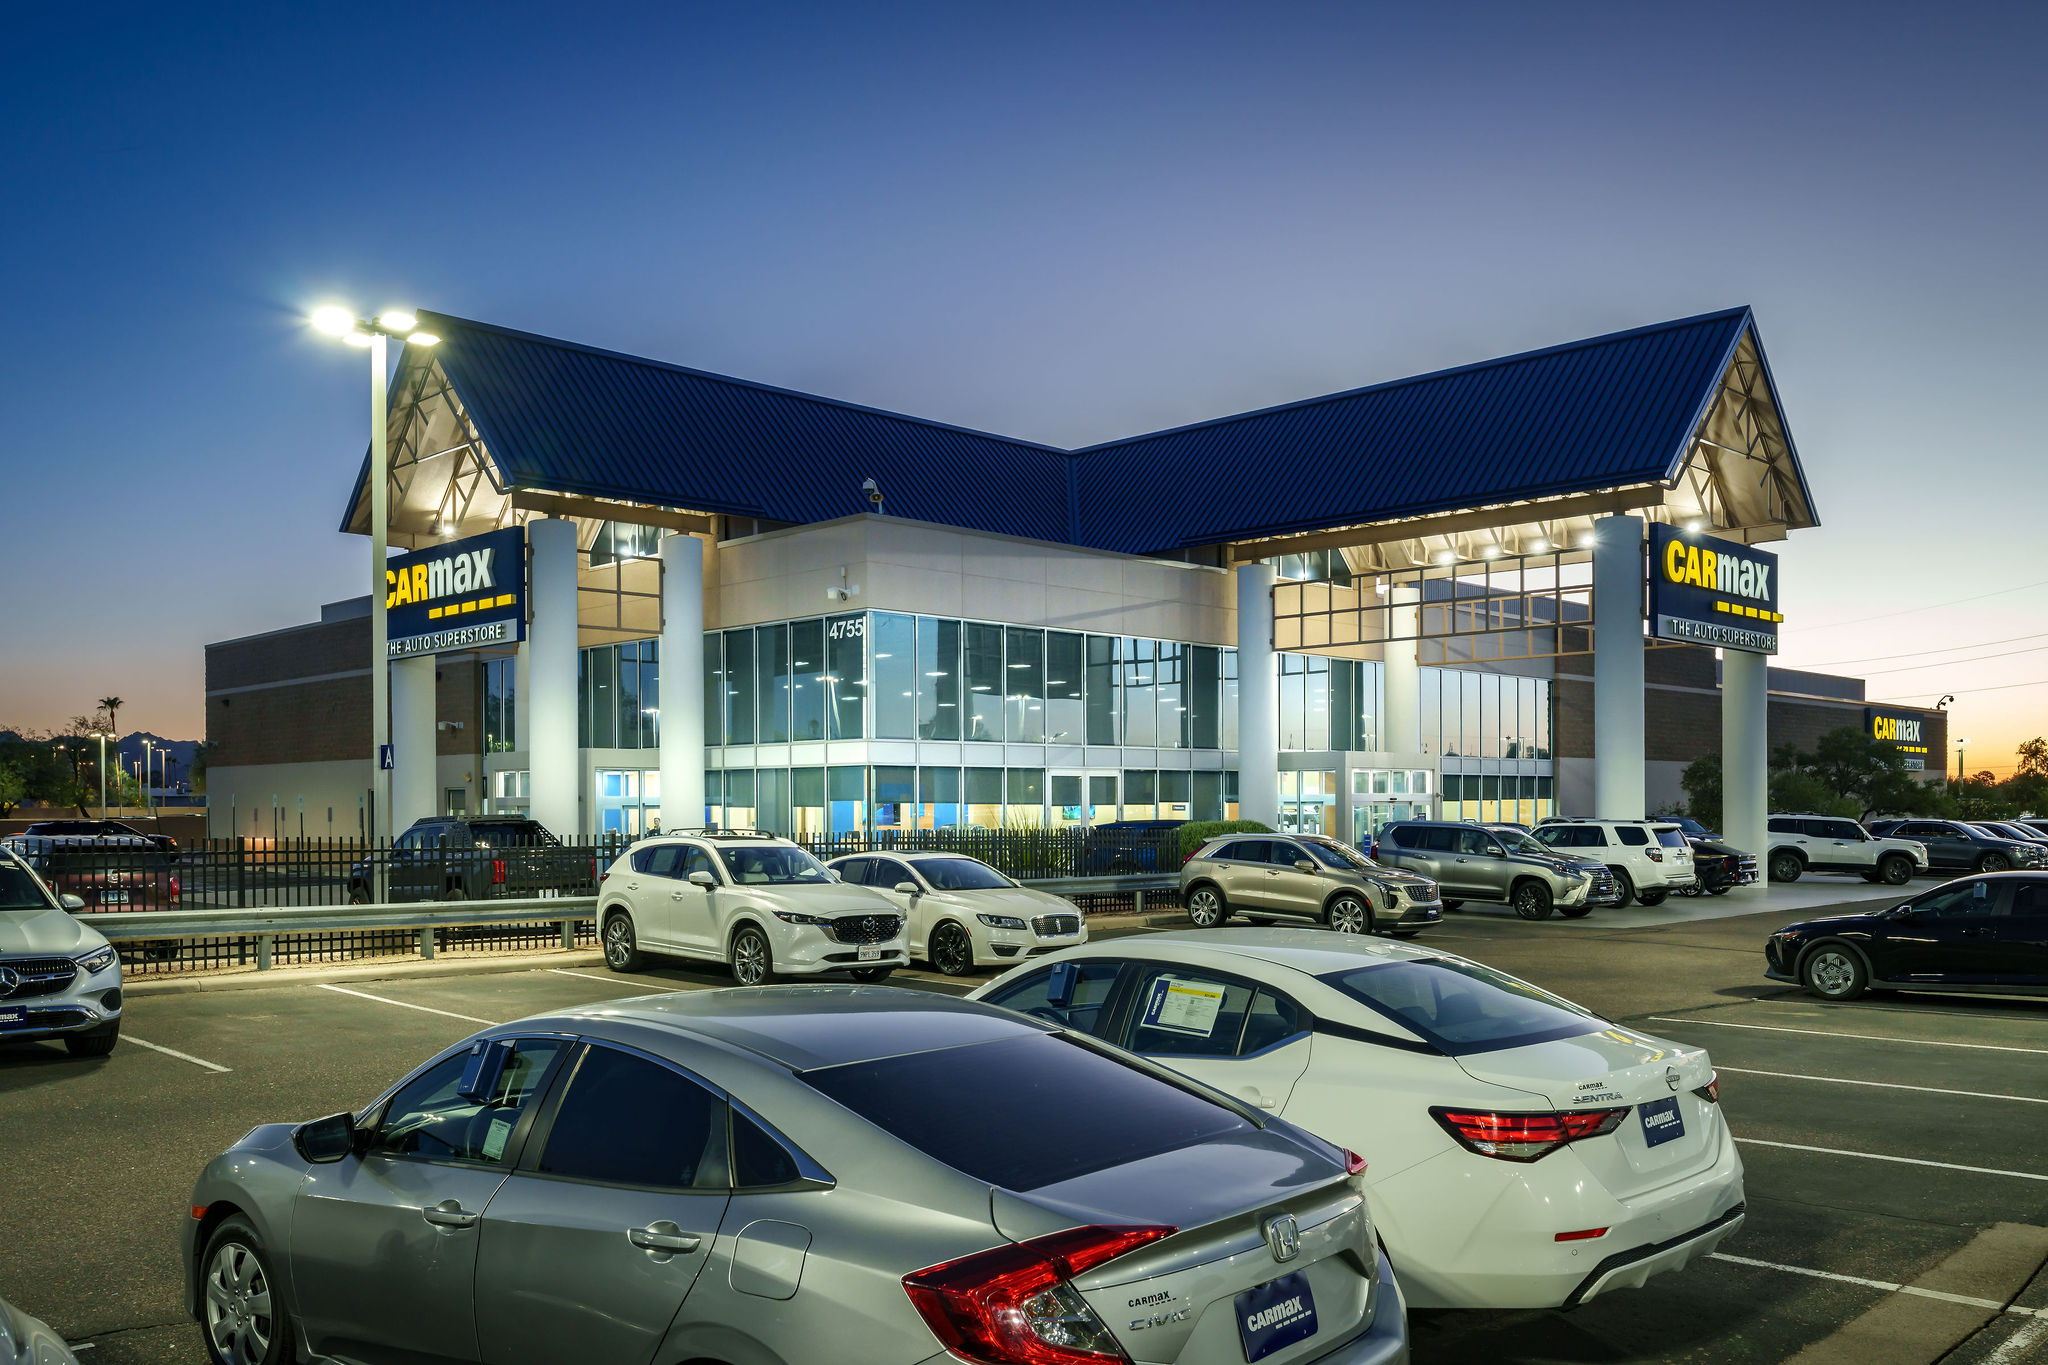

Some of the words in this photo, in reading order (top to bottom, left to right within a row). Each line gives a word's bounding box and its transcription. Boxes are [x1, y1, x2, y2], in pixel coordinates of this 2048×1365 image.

[1666, 540, 1770, 601] CARmax
[387, 641, 401, 656] THE
[405, 636, 431, 652] AUTO
[434, 624, 502, 648] SUPERSTORE
[829, 618, 863, 640] 4755
[1672, 619, 1690, 636] THE
[1693, 626, 1719, 641] AUTO
[1721, 630, 1776, 651] SUPERSTORE
[1874, 716, 1920, 742] CARmax
[384, 746, 393, 768] A
[1578, 1081, 1604, 1091] CARmax
[1572, 1091, 1624, 1105] SENTRA
[1645, 1110, 1675, 1129] CARmax
[1128, 1291, 1170, 1308] CARmax
[1129, 1308, 1191, 1331] CIVIC
[1247, 1295, 1303, 1332] CARmax
